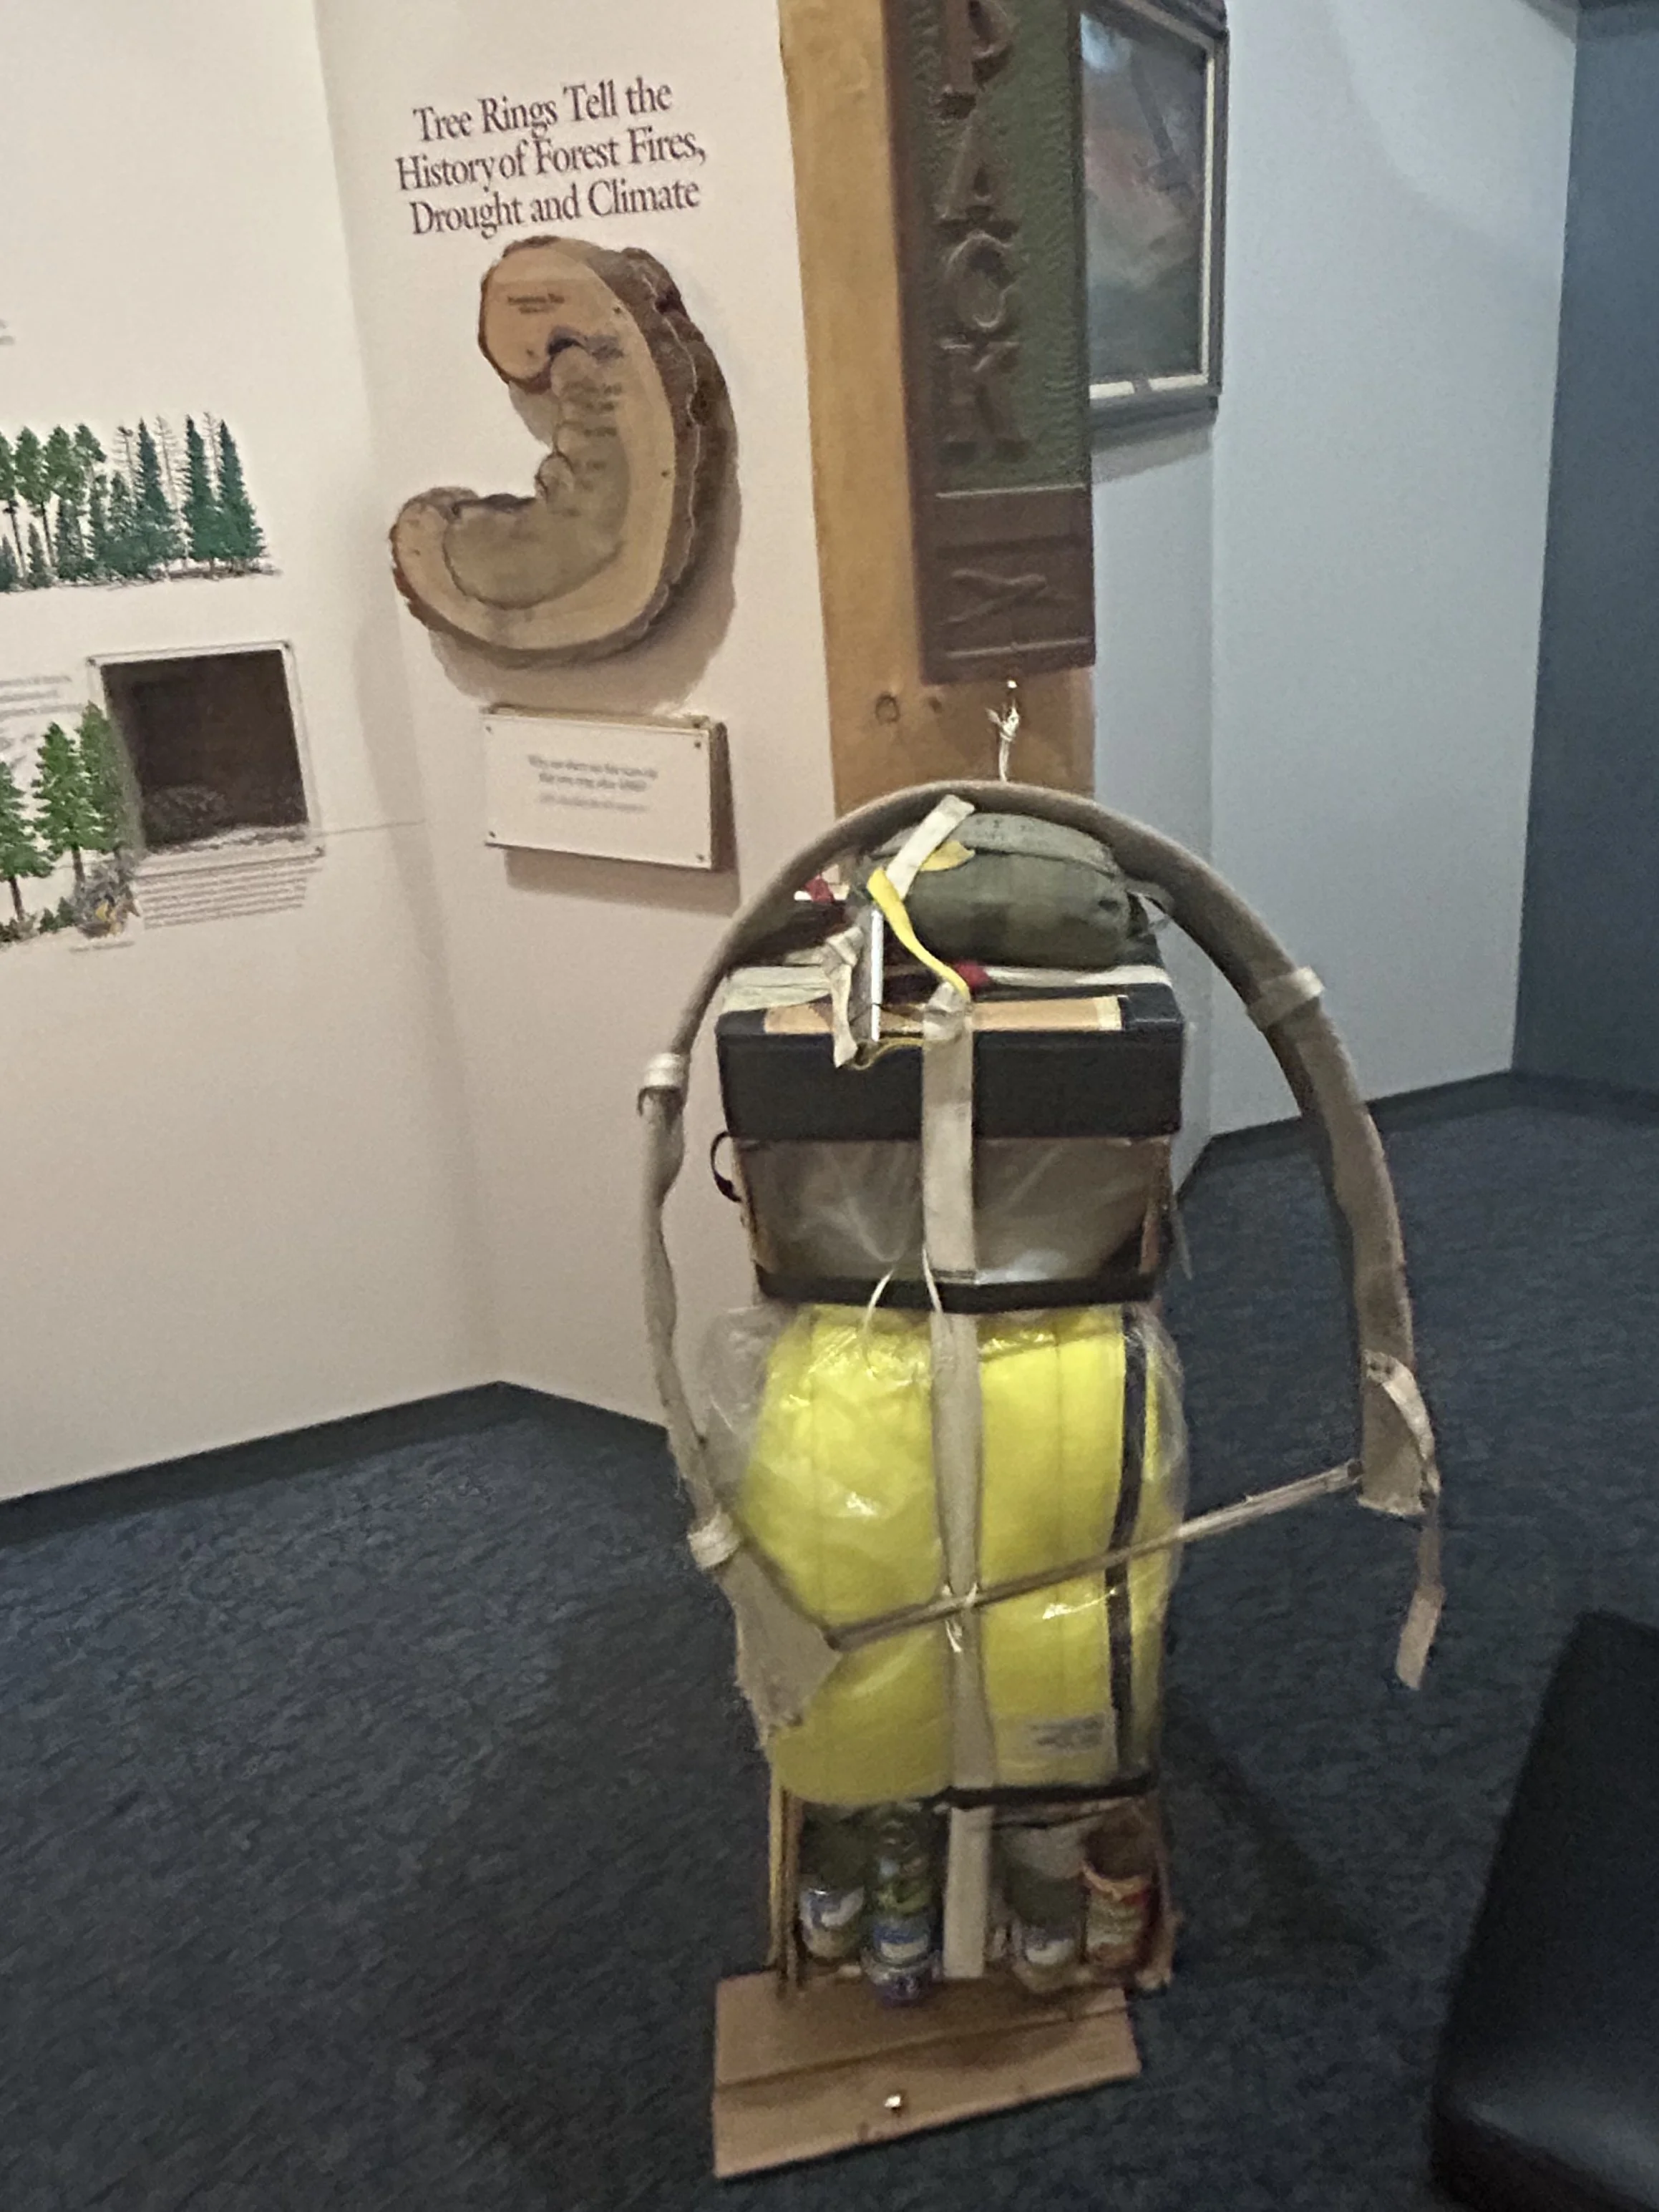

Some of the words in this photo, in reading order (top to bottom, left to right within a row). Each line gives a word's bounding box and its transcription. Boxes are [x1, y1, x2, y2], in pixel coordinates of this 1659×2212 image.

[412, 106, 472, 142] Tree
[478, 96, 558, 140] Rings
[563, 79, 618, 122] Tell
[626, 75, 672, 115] the
[396, 154, 495, 193] History
[499, 140, 528, 178] of
[535, 139, 620, 175] Forest
[627, 126, 706, 166] Fires,
[409, 191, 522, 239] Drought
[531, 183, 581, 223] and
[588, 178, 700, 216] Climate
